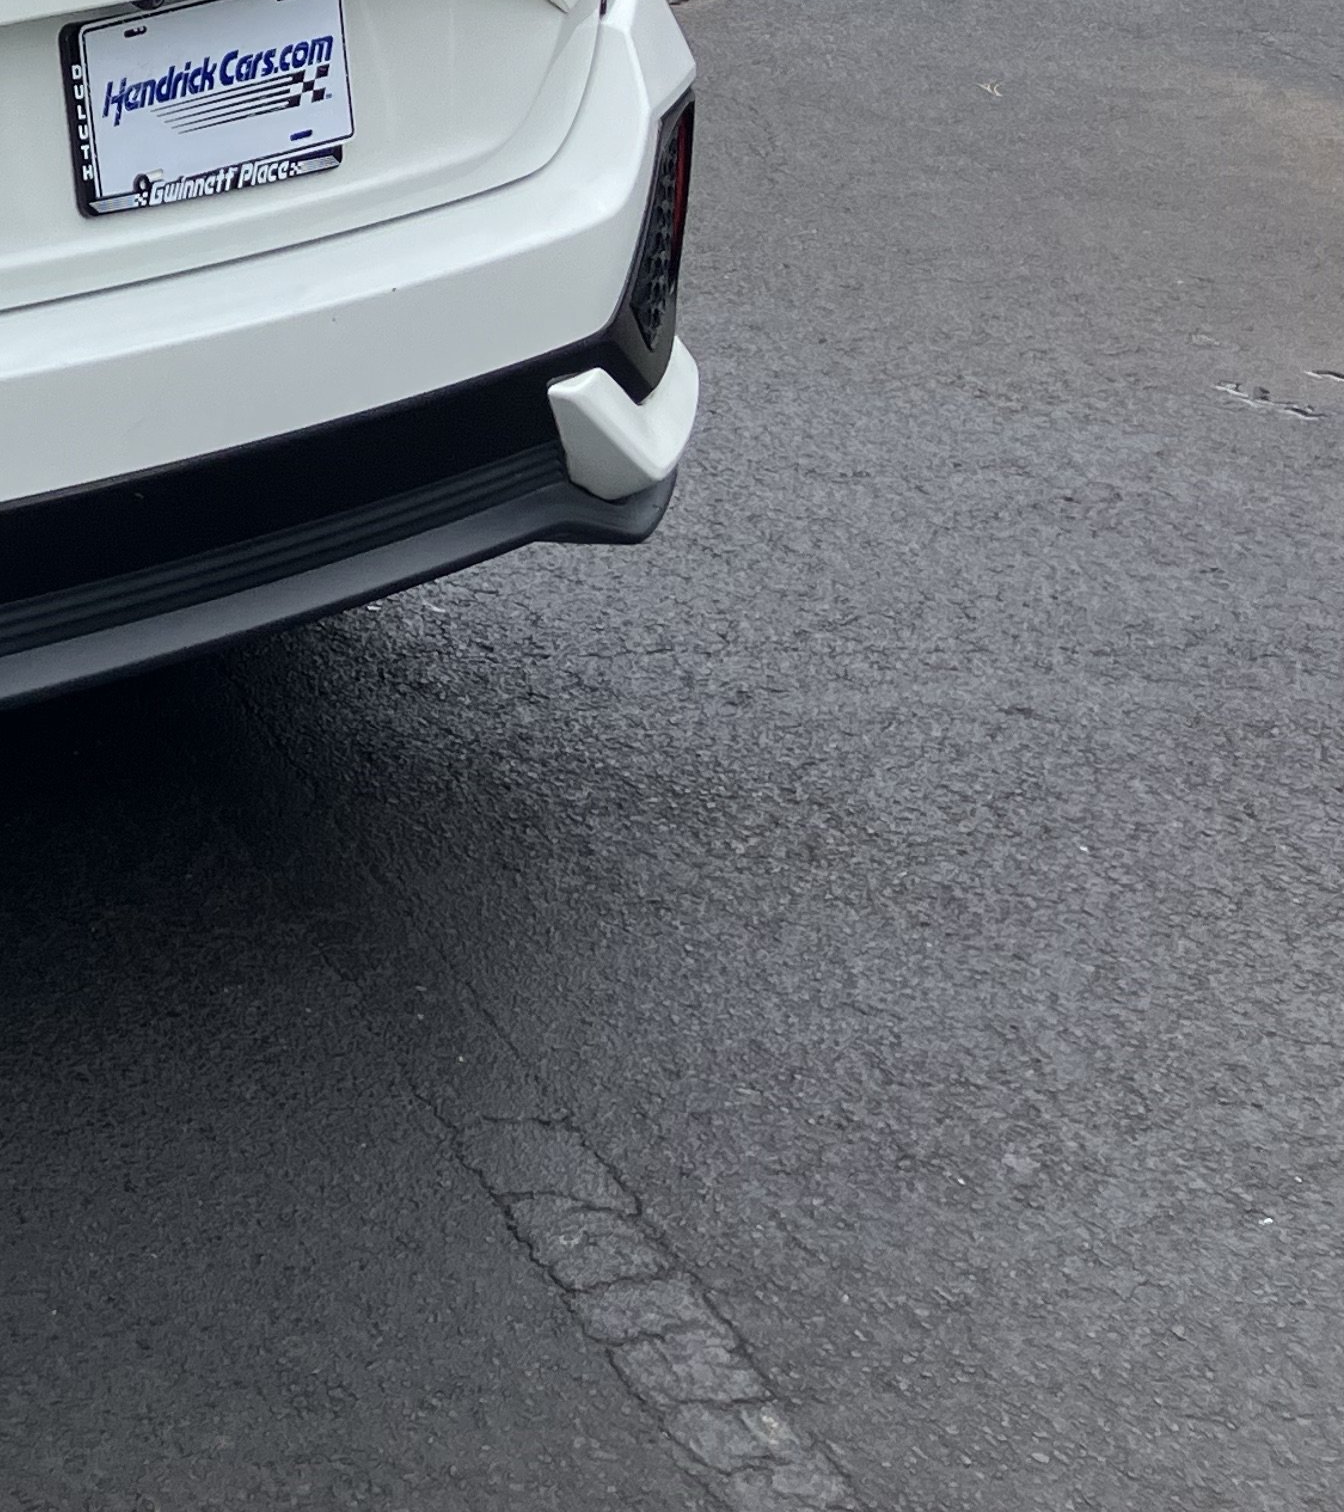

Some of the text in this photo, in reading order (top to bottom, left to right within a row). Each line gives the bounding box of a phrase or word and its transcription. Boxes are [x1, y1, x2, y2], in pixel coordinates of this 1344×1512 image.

[71, 64, 94, 181] DULUTH
[102, 35, 334, 127] Hendrick Cars.com
[149, 159, 291, 206] Gwinnett Place
